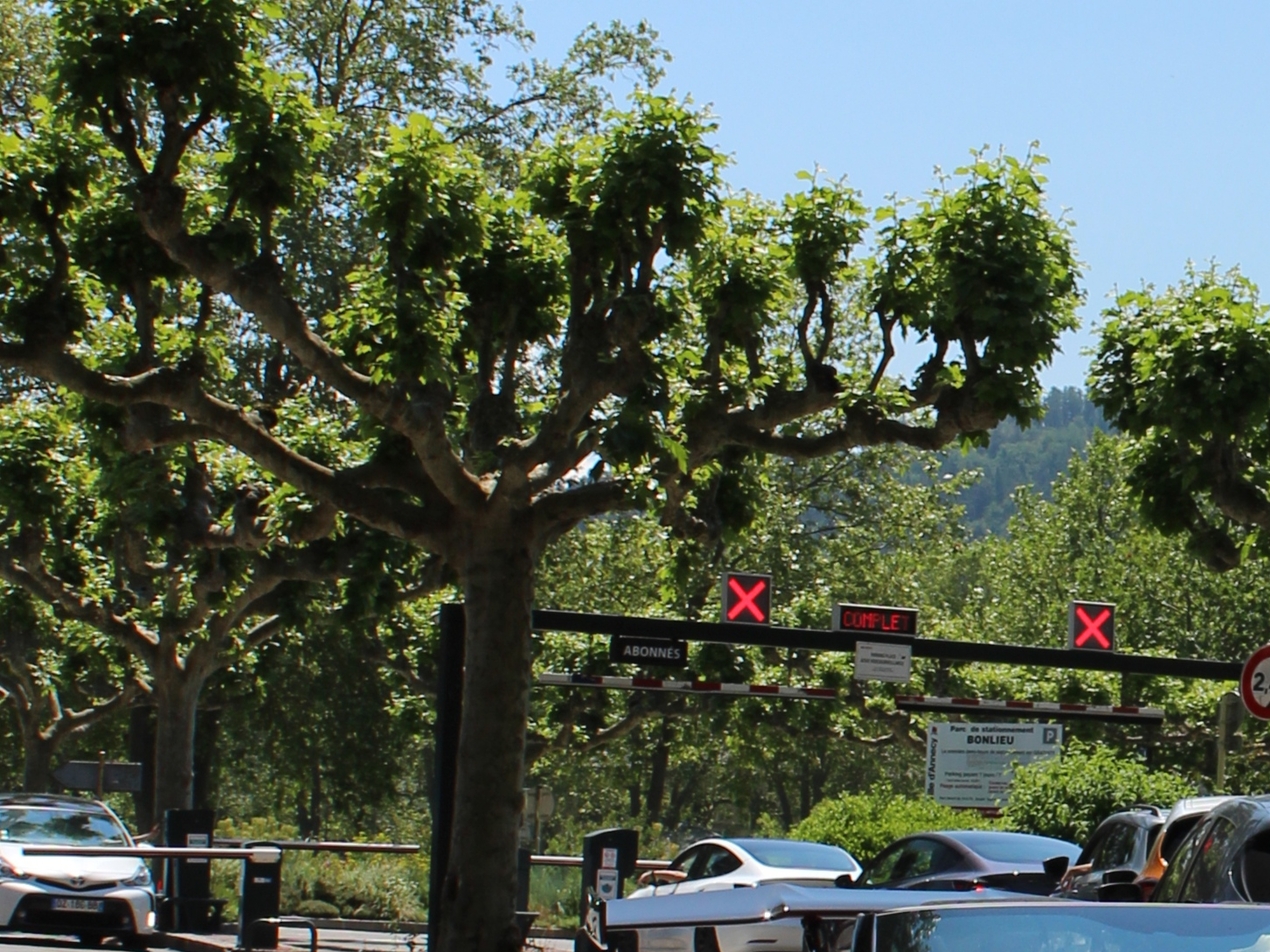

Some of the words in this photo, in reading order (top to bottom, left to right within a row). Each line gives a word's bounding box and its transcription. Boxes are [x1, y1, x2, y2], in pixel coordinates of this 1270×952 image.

[843, 610, 910, 632] COMPLET
[623, 645, 681, 660] ABONNÉS
[950, 725, 966, 733] Parc
[970, 725, 980, 733] de
[981, 726, 1034, 734] stationnement
[966, 735, 1015, 745] BONLIEU
